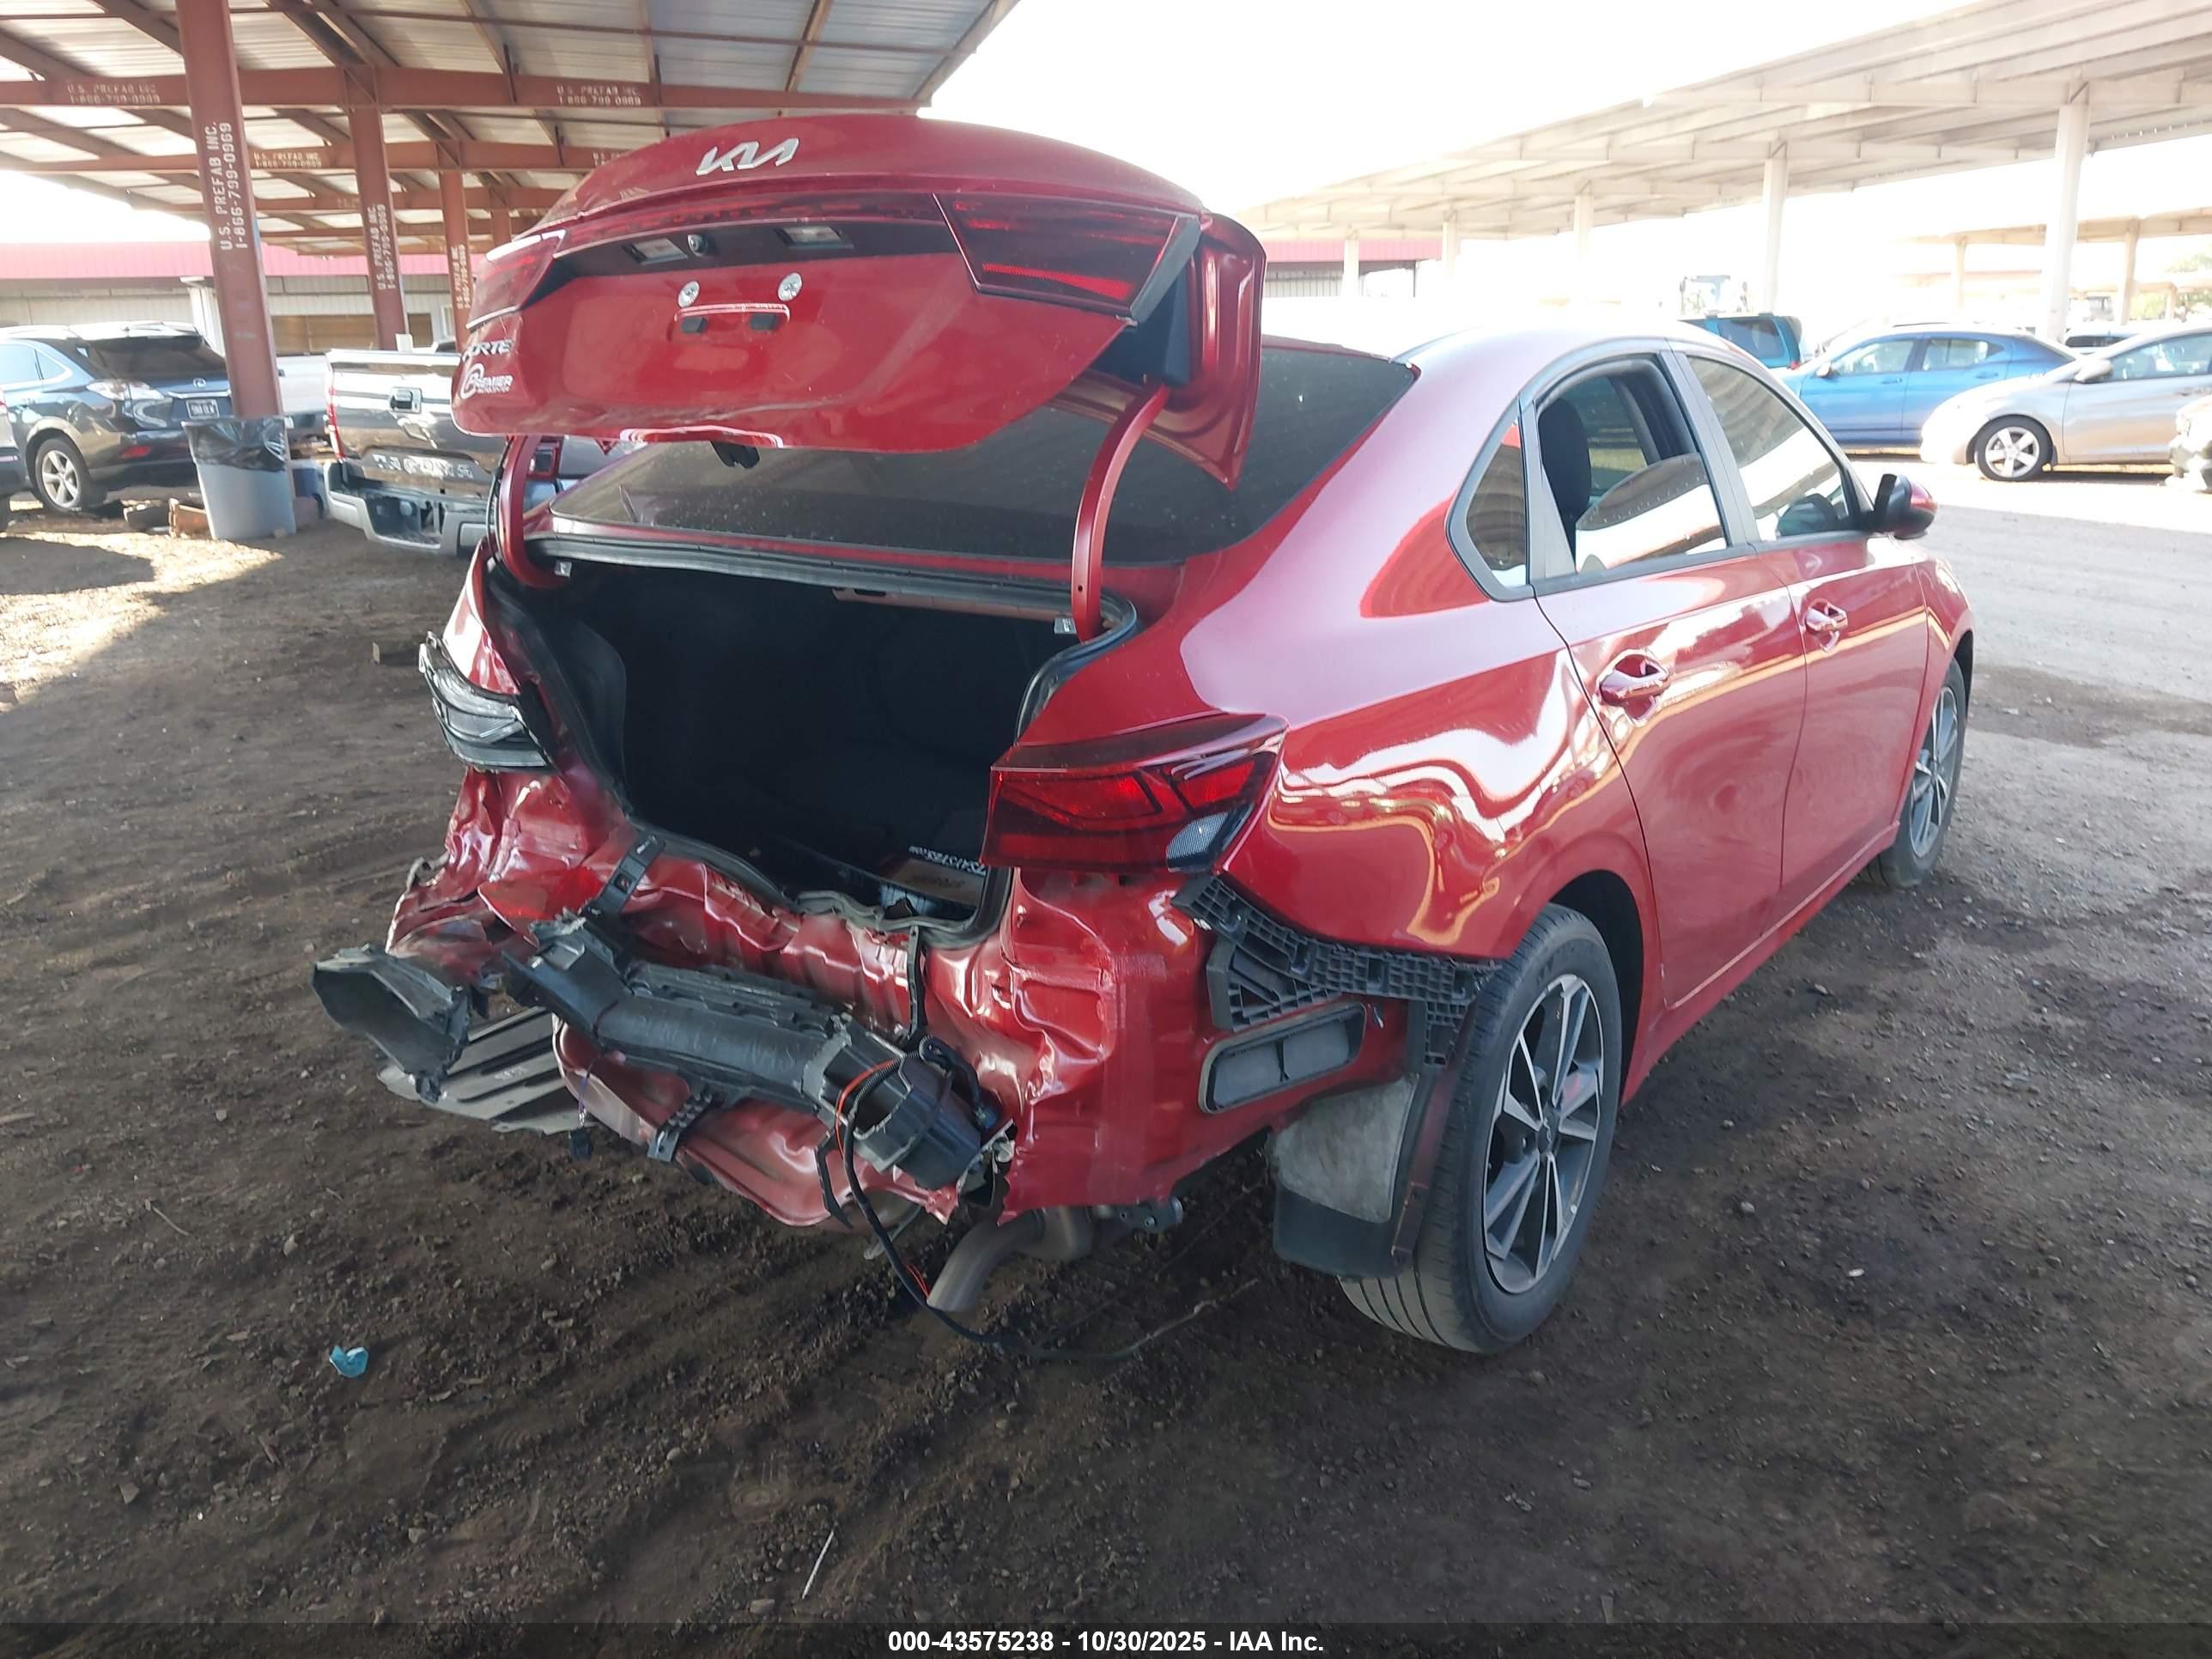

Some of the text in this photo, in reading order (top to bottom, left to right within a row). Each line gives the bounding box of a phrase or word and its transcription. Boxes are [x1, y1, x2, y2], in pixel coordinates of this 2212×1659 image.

[204, 121, 234, 251] U.S. PREFAB INC.
[219, 122, 248, 249] 1-866-799-0969
[696, 137, 799, 176] KIA
[370, 227, 383, 267] PREFAB
